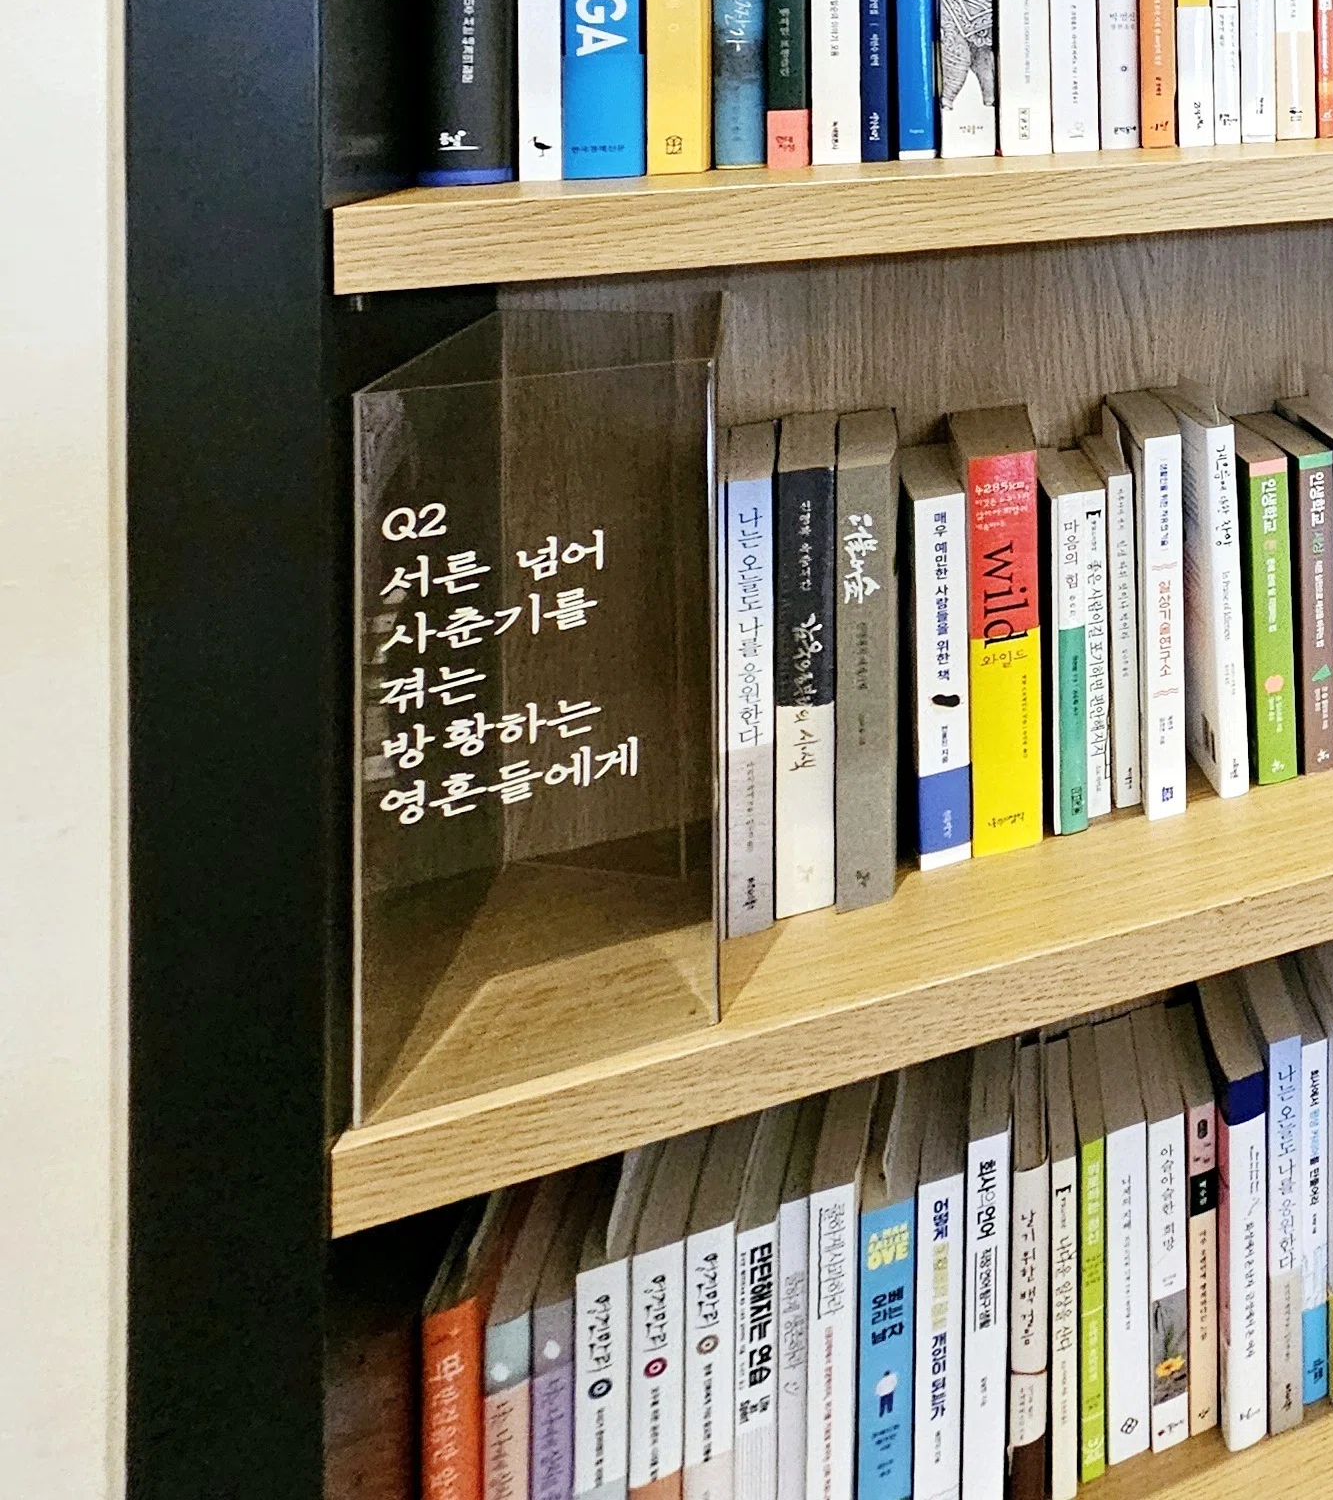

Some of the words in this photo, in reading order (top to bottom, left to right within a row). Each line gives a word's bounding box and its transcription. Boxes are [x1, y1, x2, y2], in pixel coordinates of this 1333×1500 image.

[381, 502, 447, 542] Q2
[932, 511, 949, 537] 매우
[1259, 478, 1277, 534] 인생학교
[1310, 471, 1326, 527] 인생학교
[737, 506, 764, 549] 나는
[380, 550, 490, 599] 서른
[517, 530, 604, 581] 넘어
[737, 554, 766, 613] 오늘도
[933, 542, 949, 580] 예민한
[935, 584, 951, 636] 사람들을
[983, 540, 1030, 649] wild
[380, 586, 598, 655] 사춘기를
[738, 619, 766, 658] 나를
[1158, 579, 1173, 678] 일상기술연구소
[936, 639, 951, 665] 위한
[937, 668, 952, 681] 책
[980, 649, 1028, 669] 와일드
[380, 665, 487, 713] 겪는
[738, 662, 767, 747] 응원한다
[381, 699, 602, 770] 방황하는
[380, 737, 639, 825] 영혼들에게
[748, 1242, 773, 1342] 단단해지는
[872, 1286, 904, 1309] 오베
[871, 1322, 904, 1346] 남자
[748, 1345, 772, 1387] 연습
